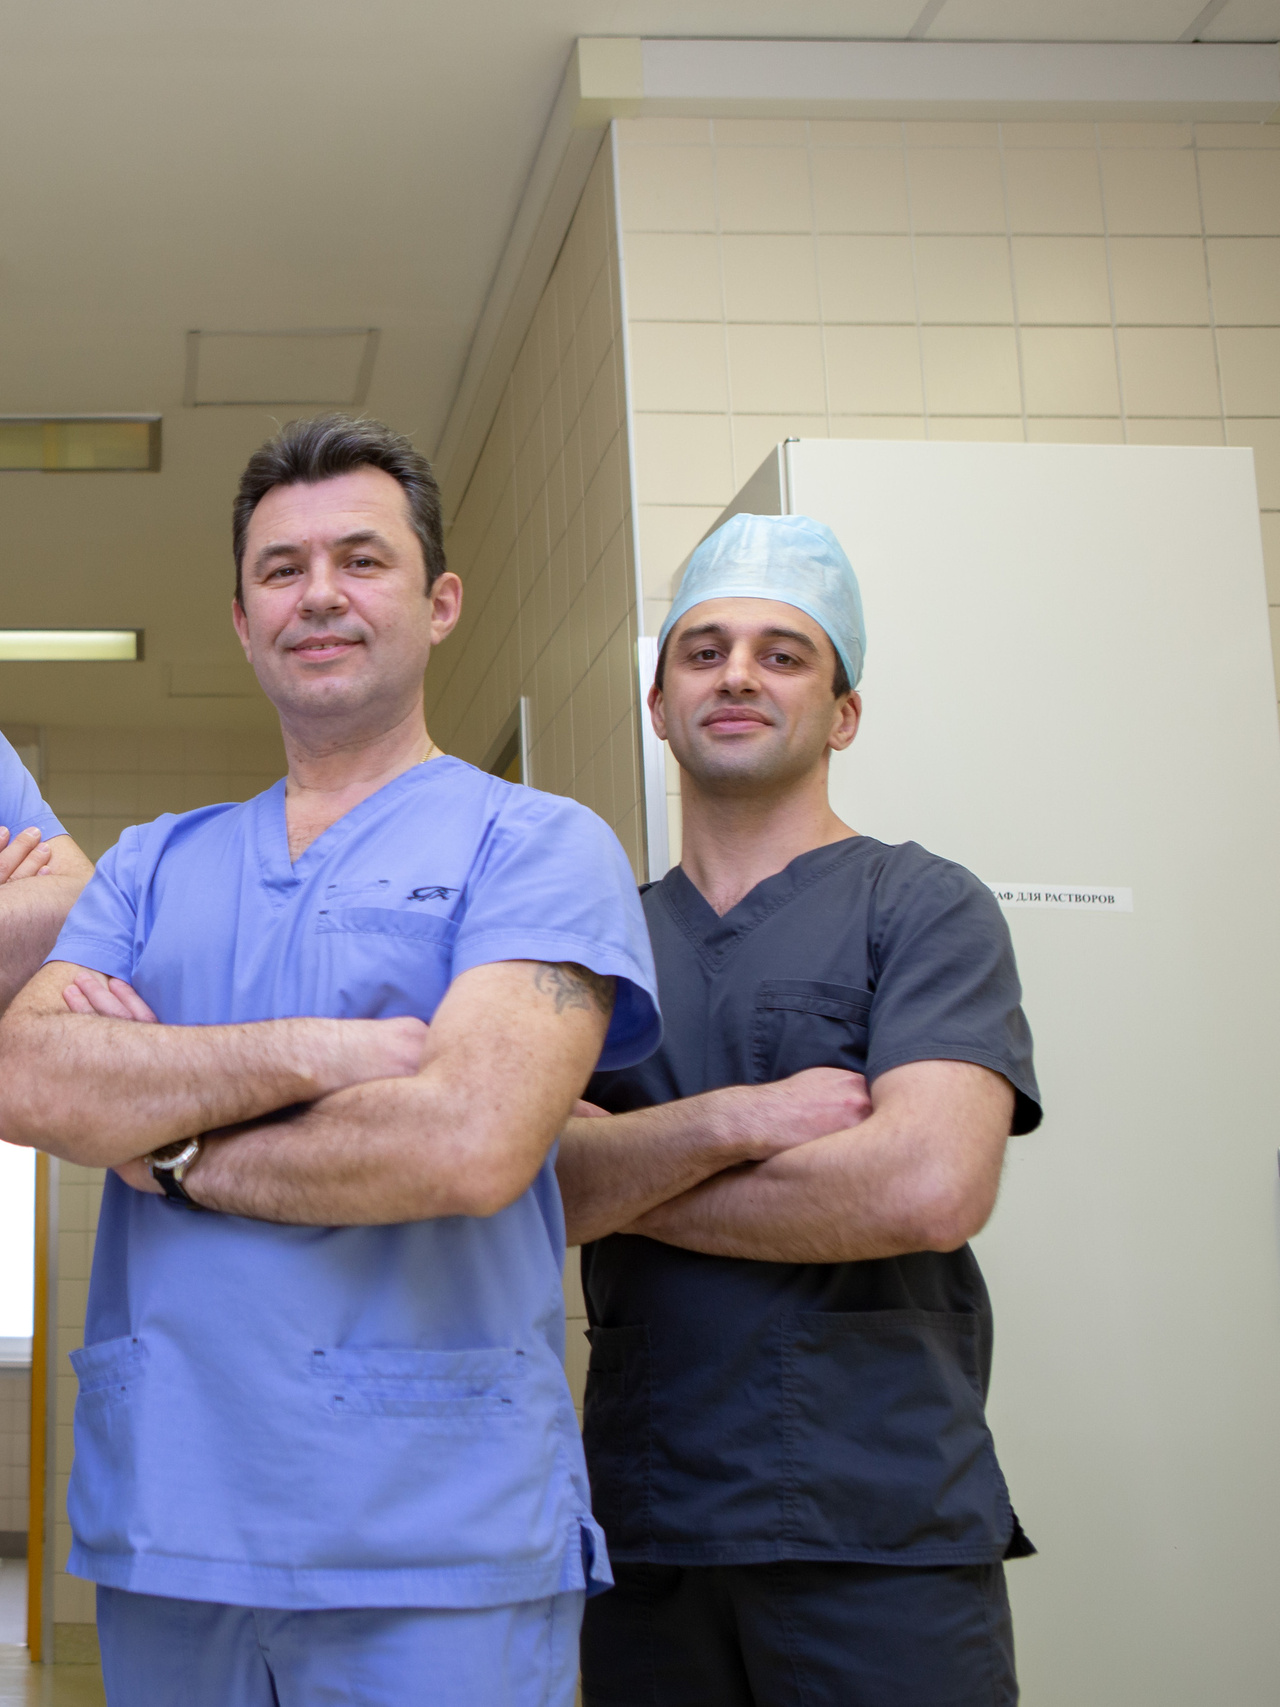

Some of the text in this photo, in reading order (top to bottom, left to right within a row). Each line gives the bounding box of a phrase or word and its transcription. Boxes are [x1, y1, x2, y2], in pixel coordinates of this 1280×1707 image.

[993, 891, 1115, 904] АФ ДЛЯ РАСТВОРОВ
